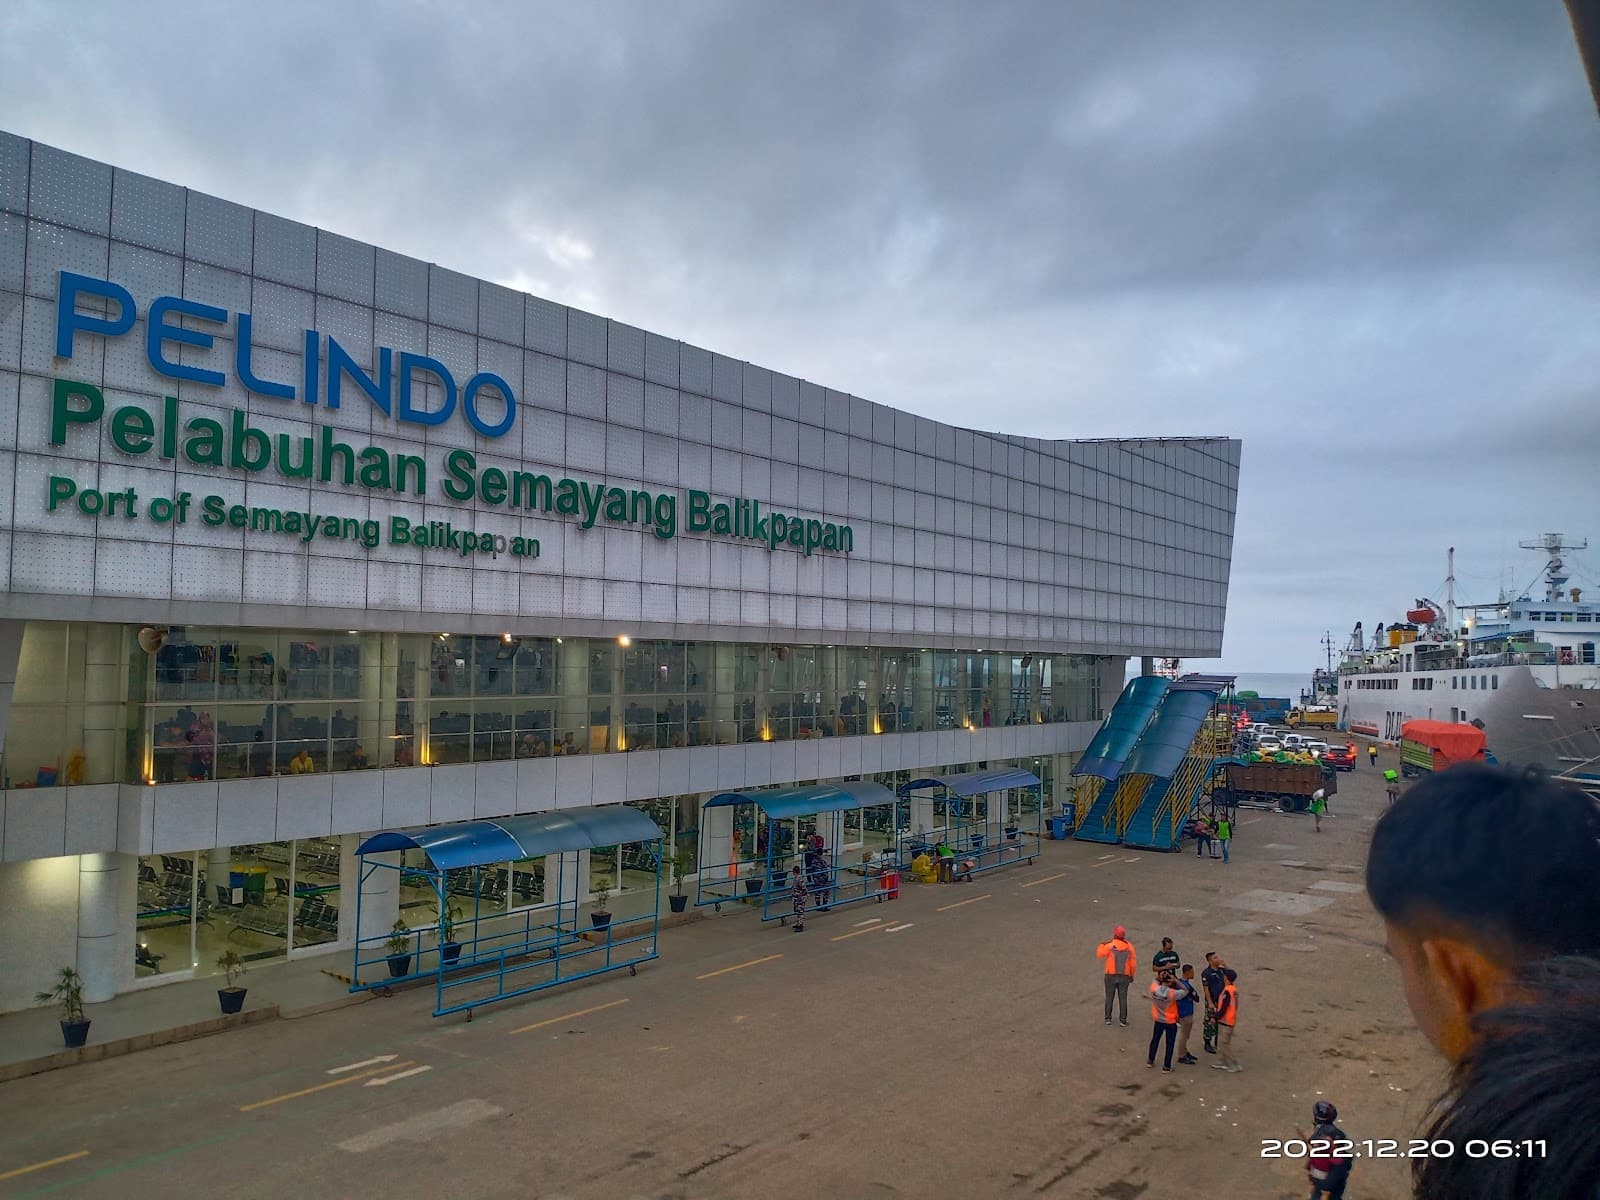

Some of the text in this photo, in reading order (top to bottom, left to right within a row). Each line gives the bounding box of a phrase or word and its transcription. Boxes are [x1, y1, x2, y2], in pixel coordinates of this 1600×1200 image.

[56, 270, 517, 438] PELINDO
[48, 476, 540, 559] Port of Semayang Balikpapan
[51, 379, 854, 557] Pelabuhan Semayang Balikpapan
